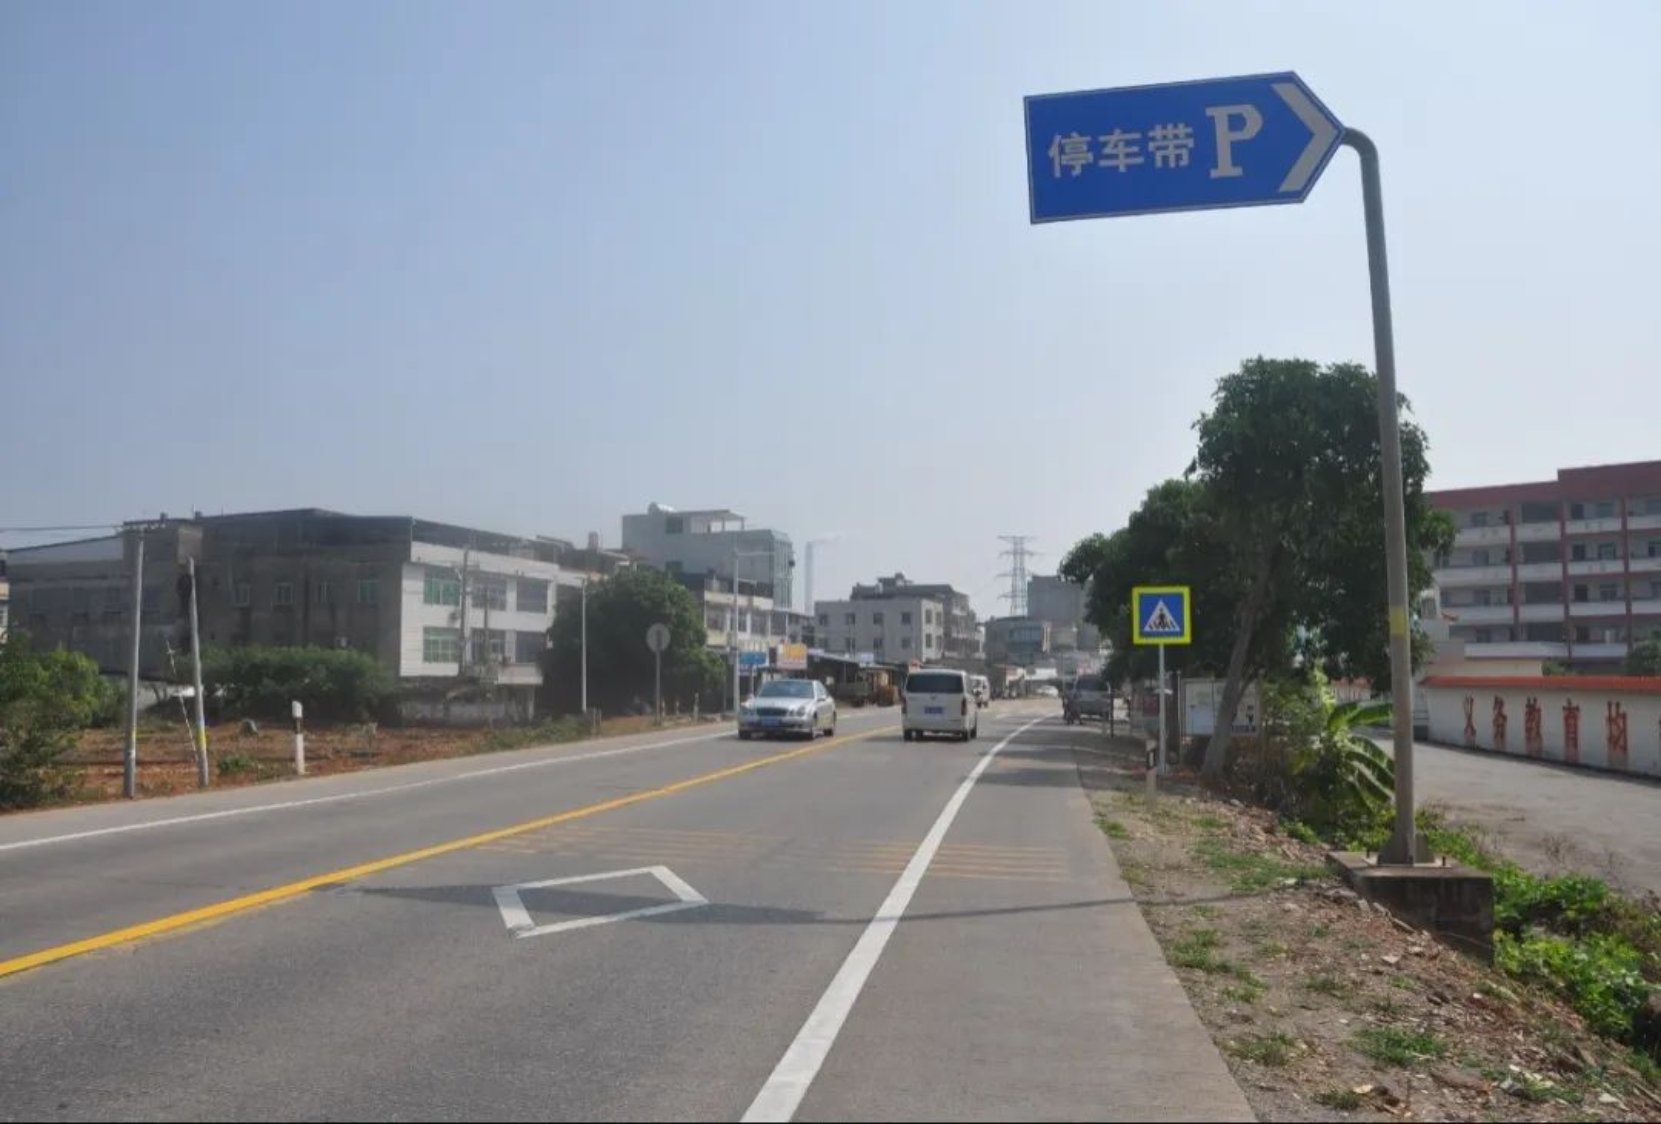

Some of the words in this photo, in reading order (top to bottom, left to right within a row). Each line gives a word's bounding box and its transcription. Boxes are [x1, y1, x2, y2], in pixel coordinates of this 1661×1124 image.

[1047, 122, 1195, 178] 停车带
[1205, 103, 1264, 179] P
[1463, 694, 1661, 757] 义务教育均
